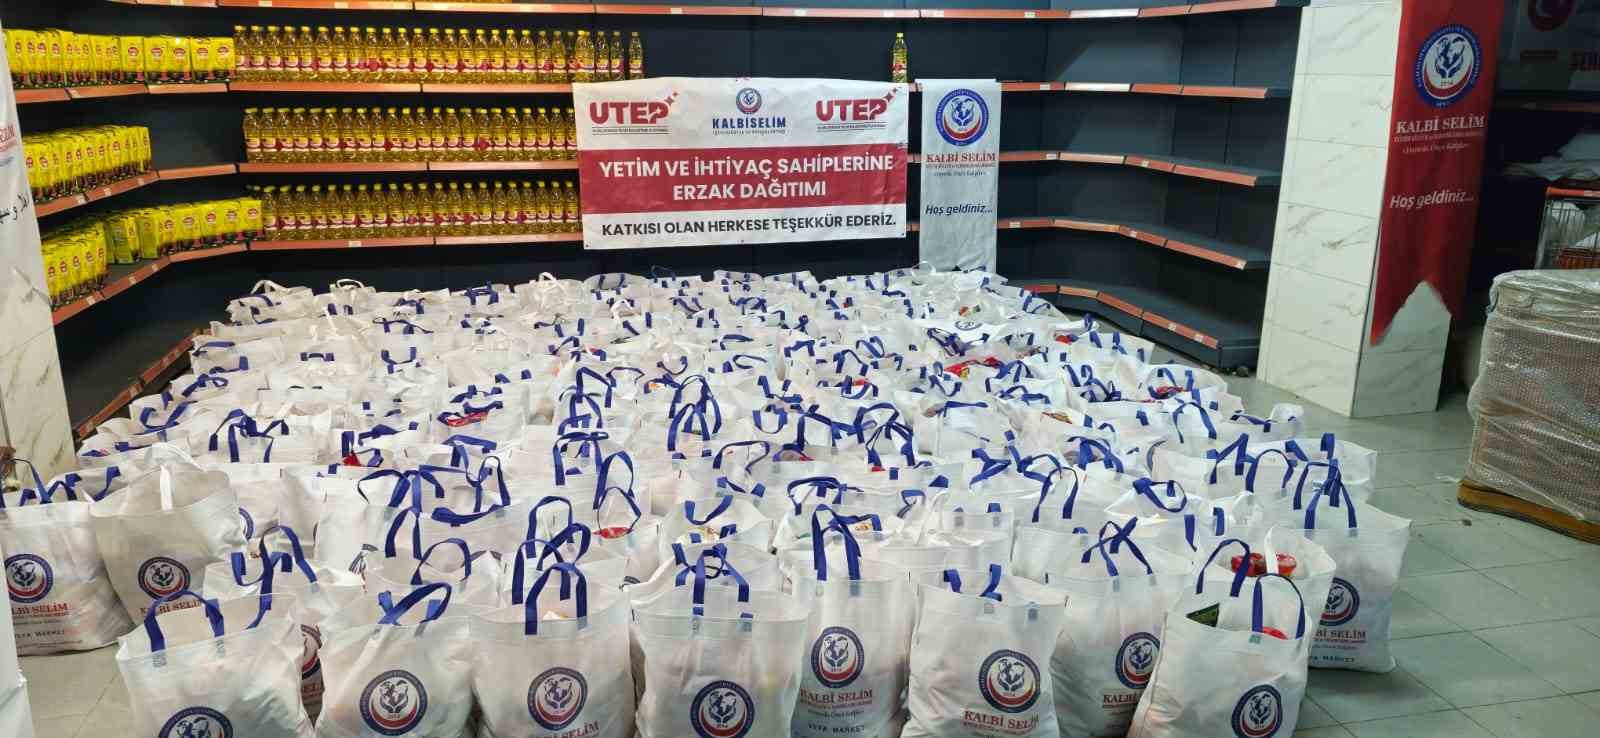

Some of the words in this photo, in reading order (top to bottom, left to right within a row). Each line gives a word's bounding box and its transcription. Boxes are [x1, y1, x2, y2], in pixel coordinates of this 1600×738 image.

[590, 101, 669, 125] UTEP
[816, 98, 887, 122] UTEP
[1396, 116, 1440, 134] KALBİ
[1442, 113, 1485, 129] SELİM
[599, 156, 661, 178] YETİM
[664, 160, 690, 177] VE
[694, 156, 773, 180] İHTİYAÇ
[777, 152, 894, 174] SAHİPLERİNE
[927, 152, 959, 163] KALBİ
[961, 150, 996, 162] SELİM
[673, 184, 735, 201] ERZAK
[740, 178, 826, 199] DAĞITIMI
[925, 203, 945, 216] Hoş
[1390, 194, 1415, 211] Hoş
[602, 222, 661, 237] KATKISI
[664, 220, 705, 234] OLAN
[708, 218, 770, 233] HERKESE
[772, 213, 843, 233] TEŞEKKÜR
[846, 211, 896, 229] EDERİZ.
